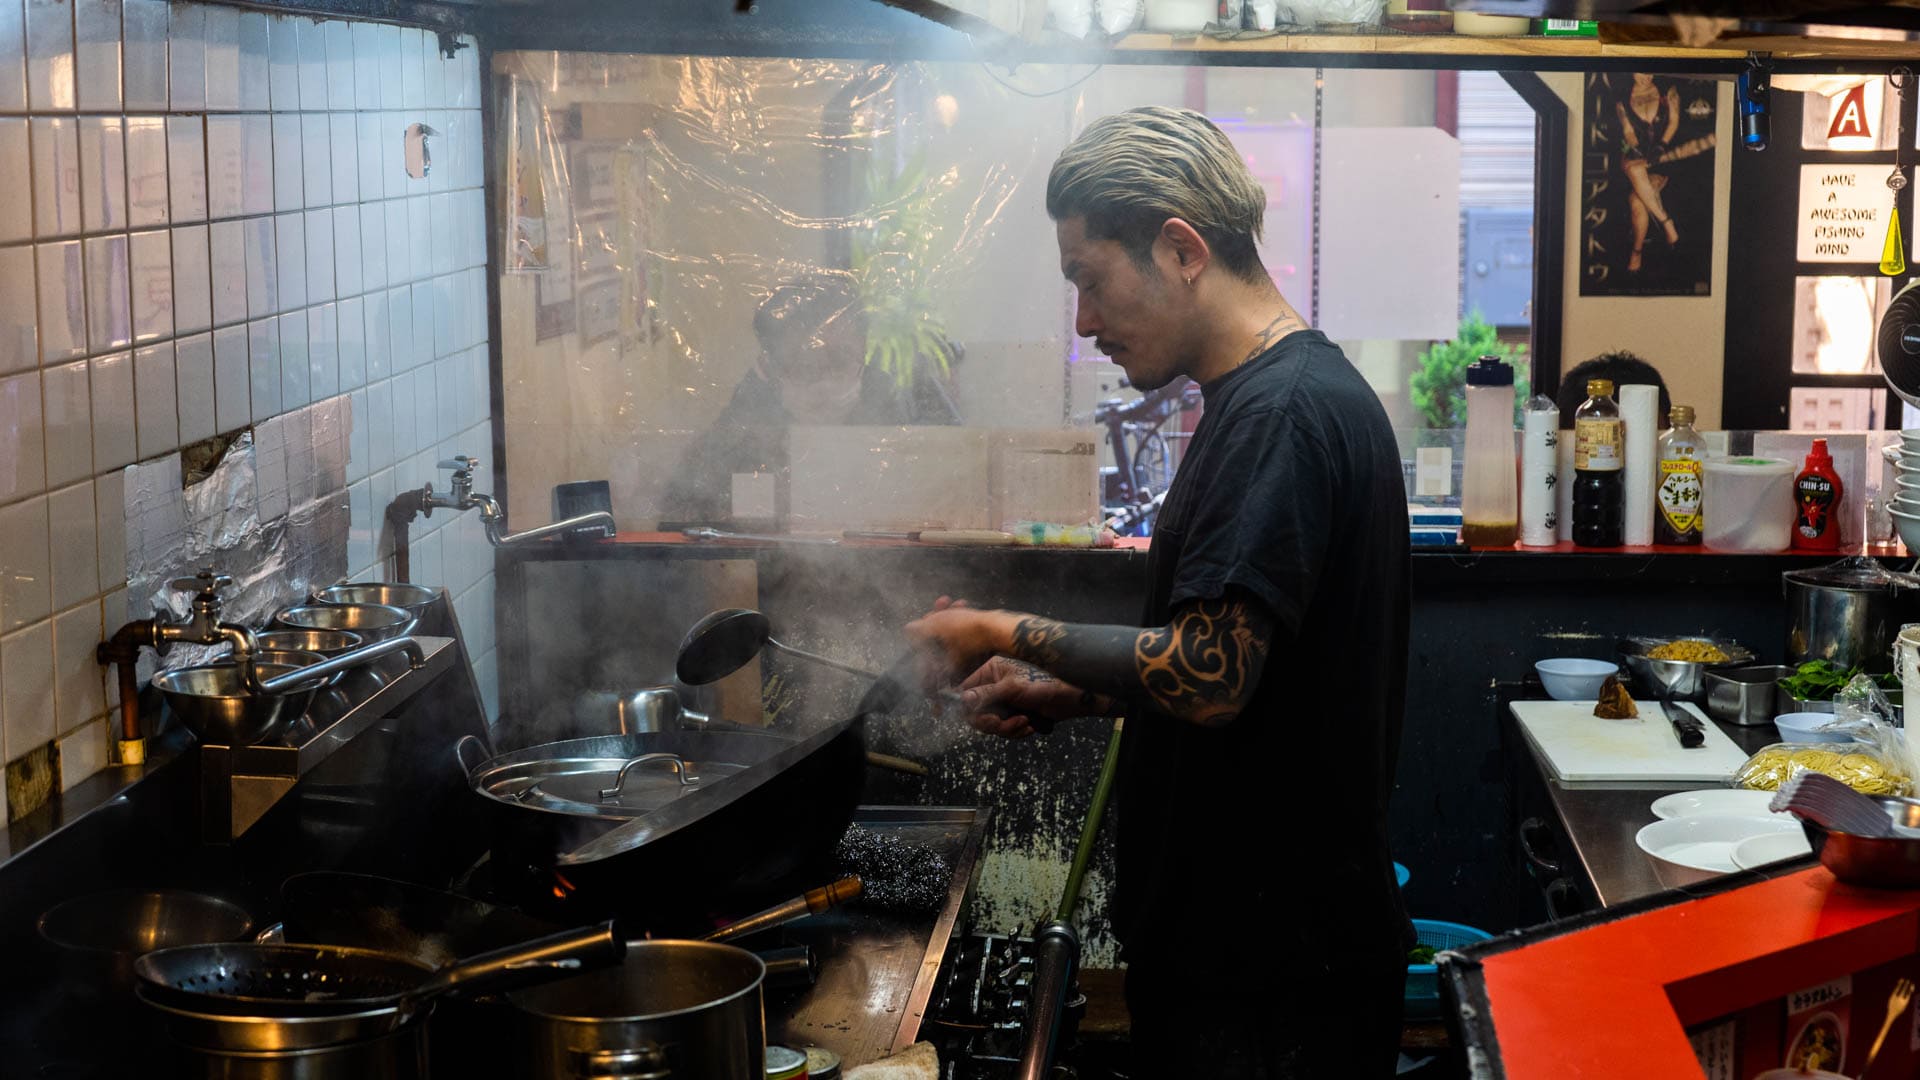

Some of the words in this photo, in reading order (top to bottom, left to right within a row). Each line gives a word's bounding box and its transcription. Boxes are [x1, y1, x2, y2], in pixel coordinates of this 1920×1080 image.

[1838, 99, 1861, 132] A
[1822, 174, 1855, 186] HAVE
[1828, 191, 1837, 202] A
[1811, 208, 1877, 221] AWESOME
[1814, 226, 1865, 239] FISHING
[1815, 243, 1850, 255] MIND
[1799, 480, 1830, 492] CHIN-SU
